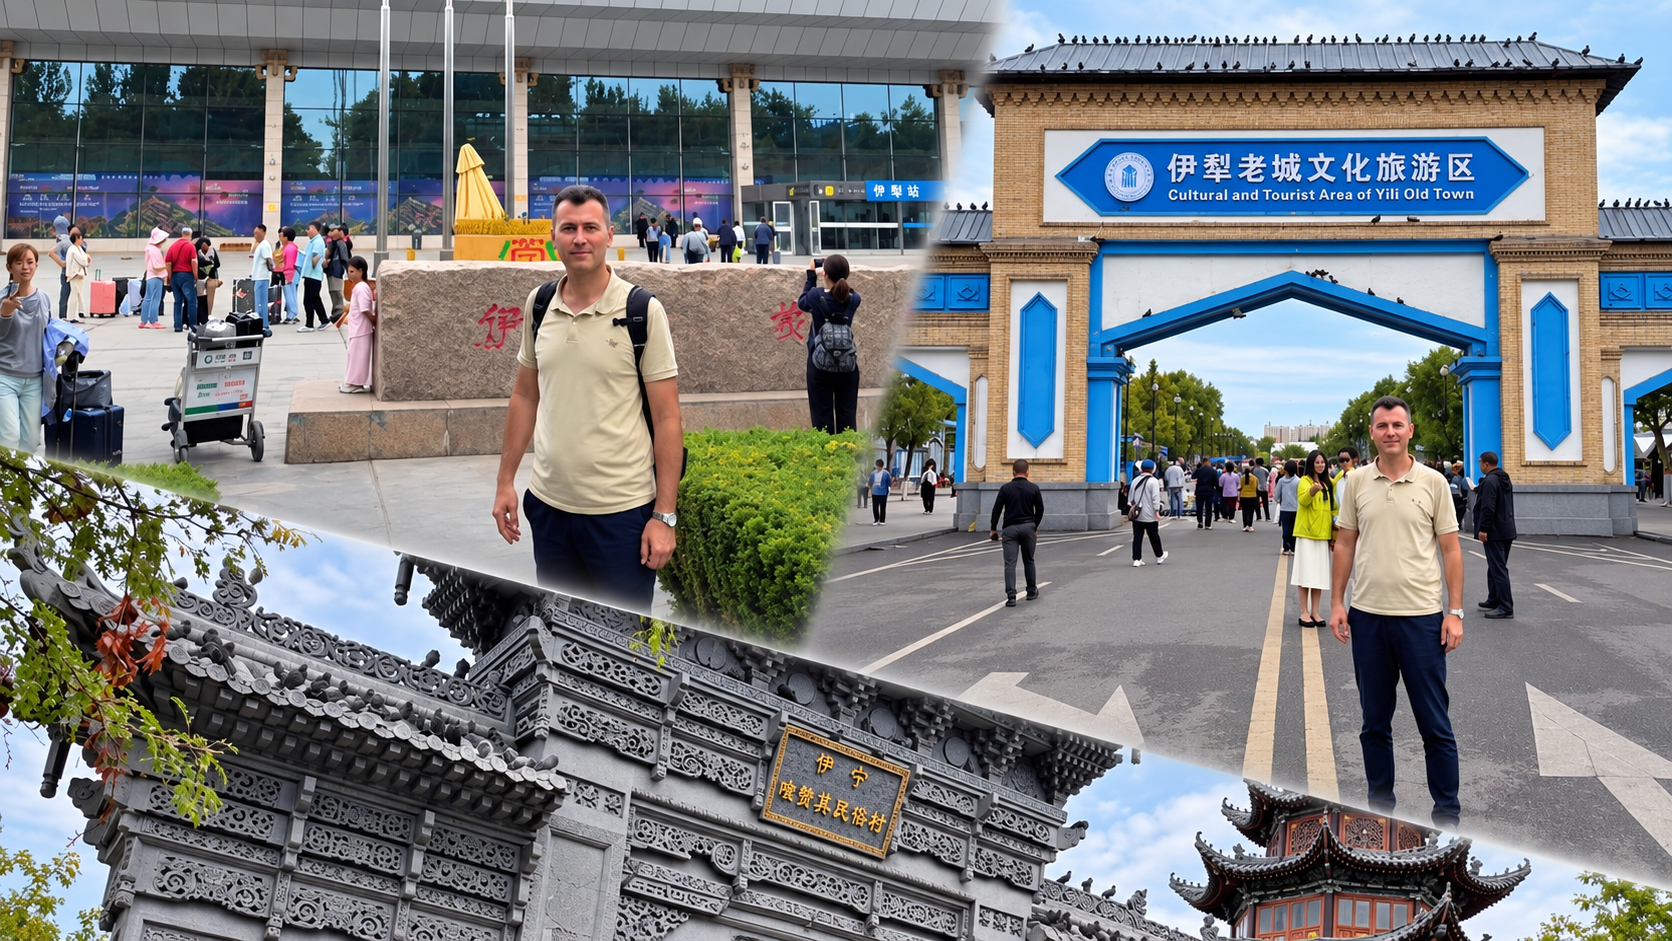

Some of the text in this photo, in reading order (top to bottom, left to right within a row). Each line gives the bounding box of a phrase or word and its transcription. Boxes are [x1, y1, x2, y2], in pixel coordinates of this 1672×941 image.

[1167, 152, 1475, 183] 伊犁老城文化旅游区
[1168, 188, 1475, 201] Cultural and Tourist Area of Yili Old Town
[816, 753, 869, 788] 伊宁
